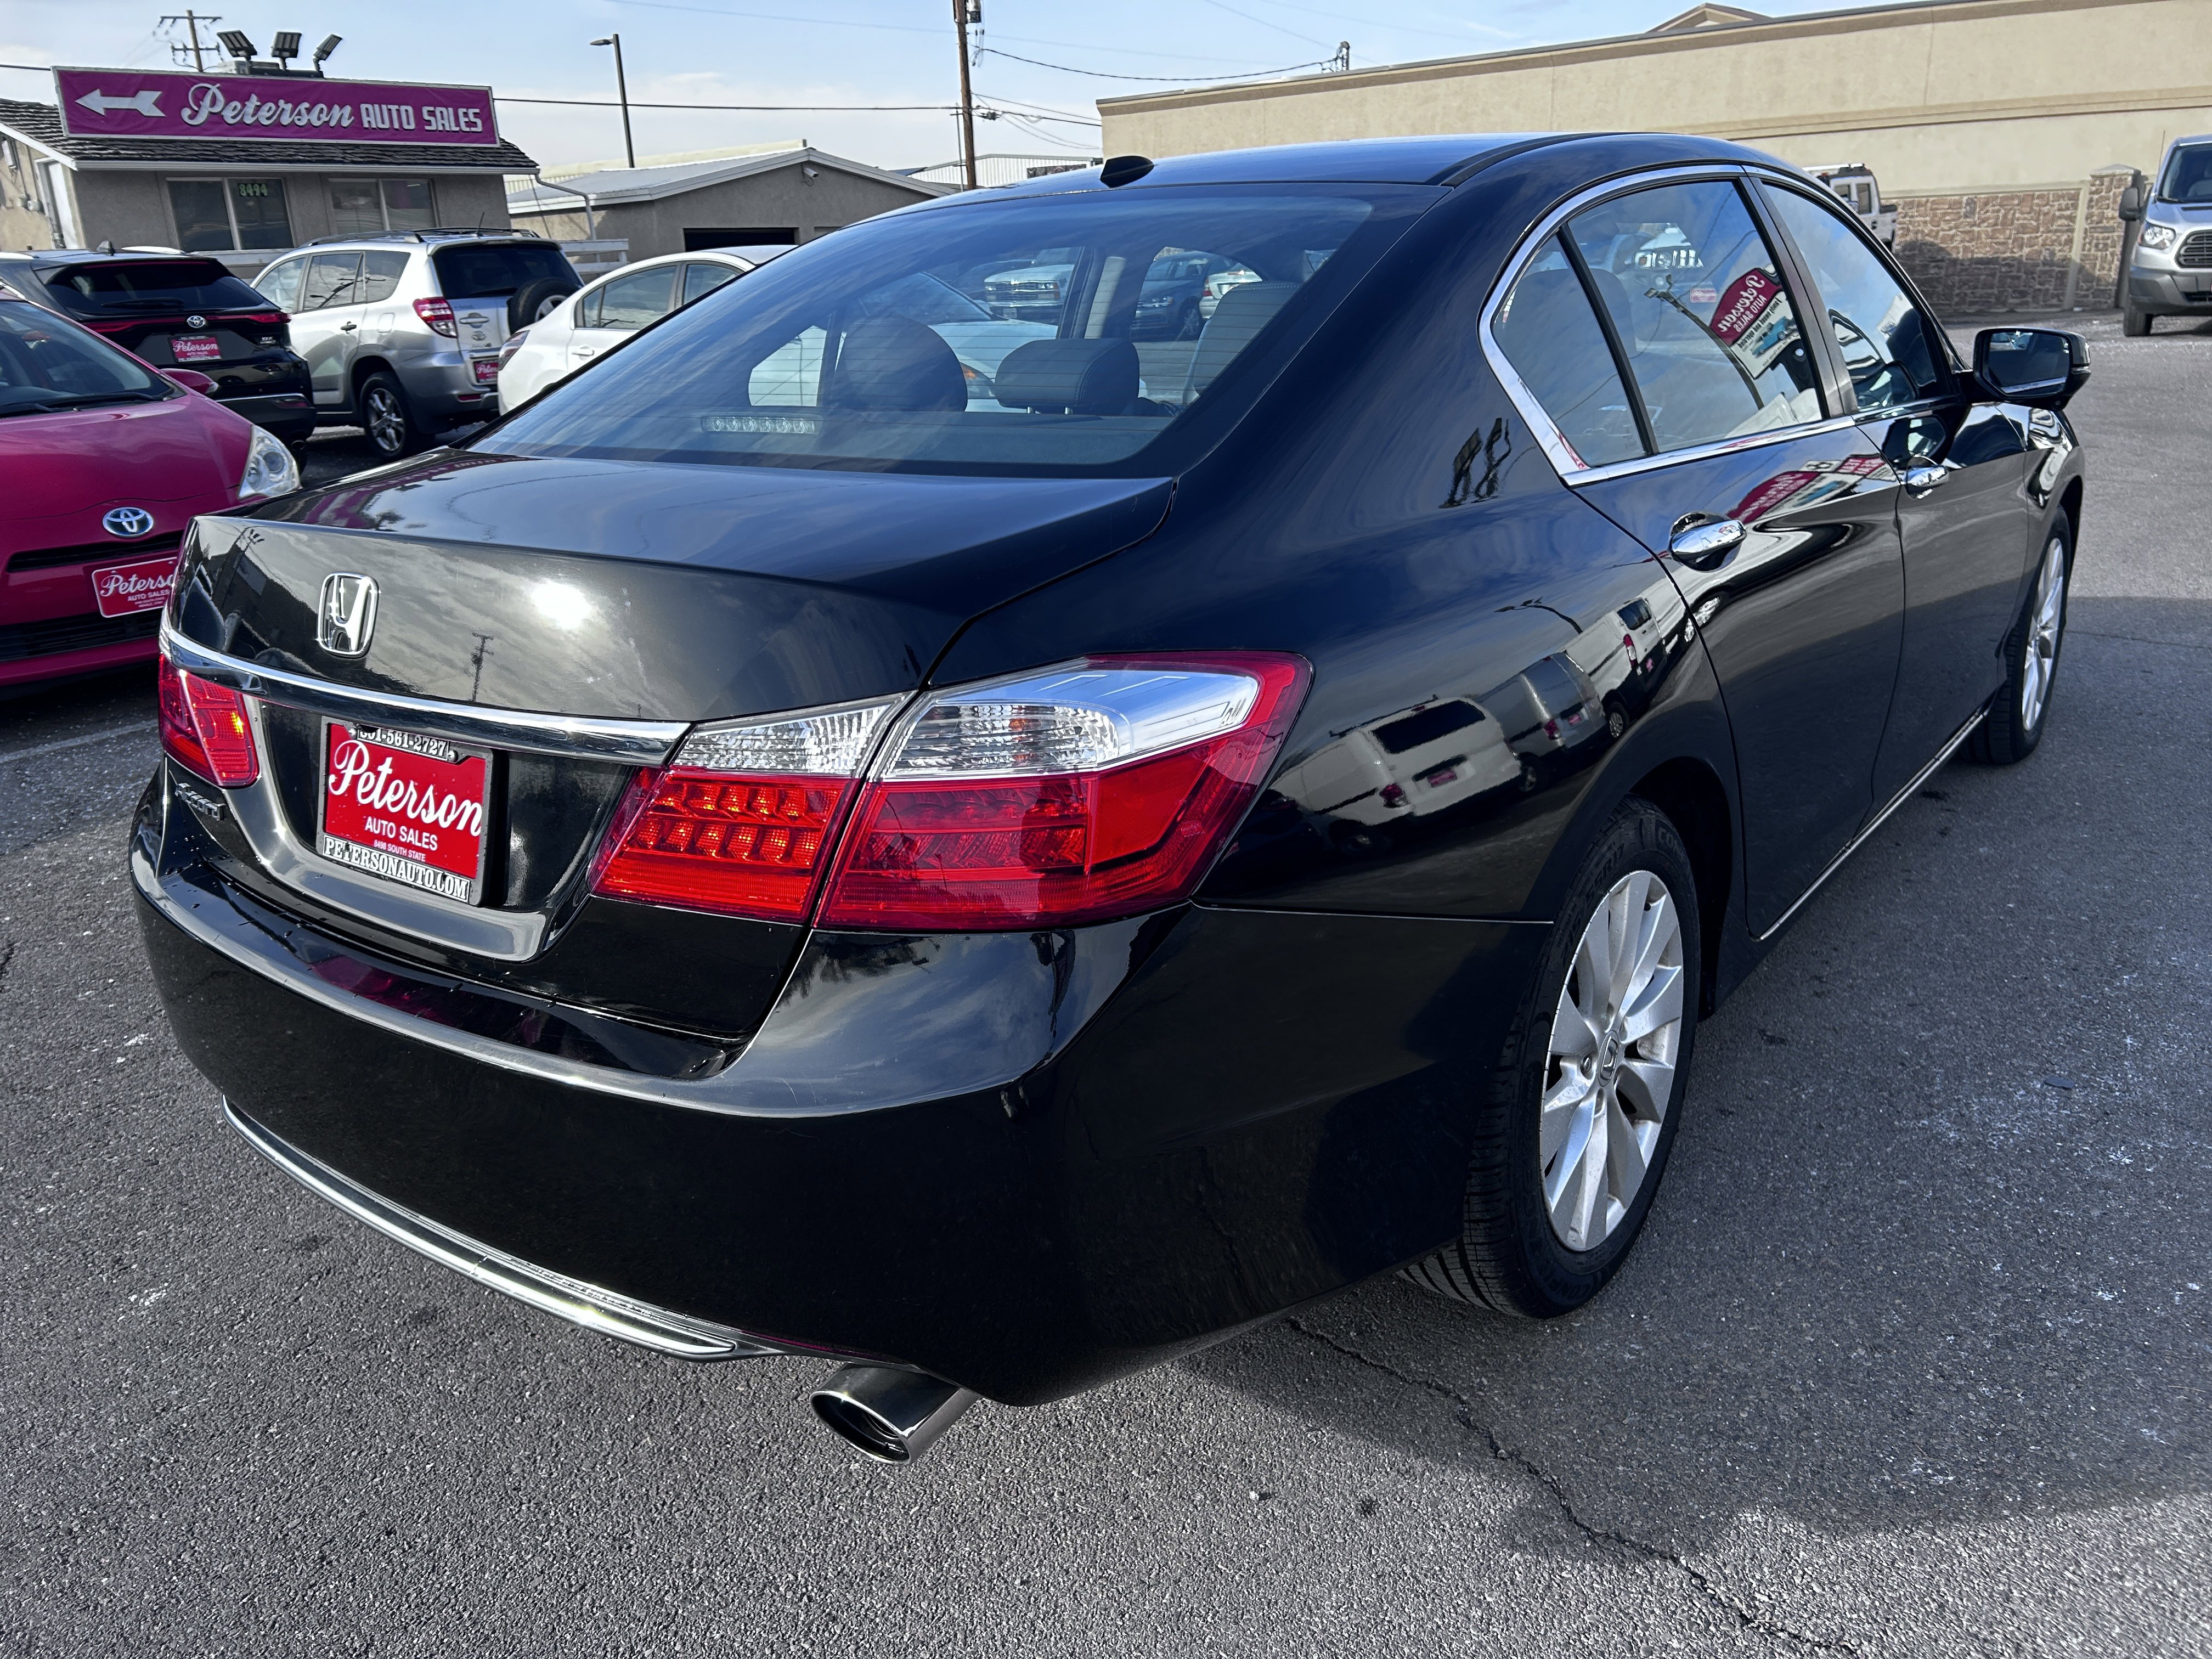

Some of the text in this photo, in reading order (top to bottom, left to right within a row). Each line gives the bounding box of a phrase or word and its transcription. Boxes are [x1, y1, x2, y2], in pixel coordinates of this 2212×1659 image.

[181, 83, 483, 132] Peterson AUTO SALES
[239, 183, 268, 196] 8494
[173, 341, 218, 352] Peterson
[100, 574, 174, 597] Peterso
[128, 593, 146, 601] AUTO
[148, 589, 170, 598] SALES
[329, 740, 482, 836] Peterson
[365, 816, 438, 851] AUTO SALES
[387, 843, 407, 856] SOUTH
[408, 850, 426, 862] STATE
[325, 837, 468, 900] PETERSONAUTO.COM
